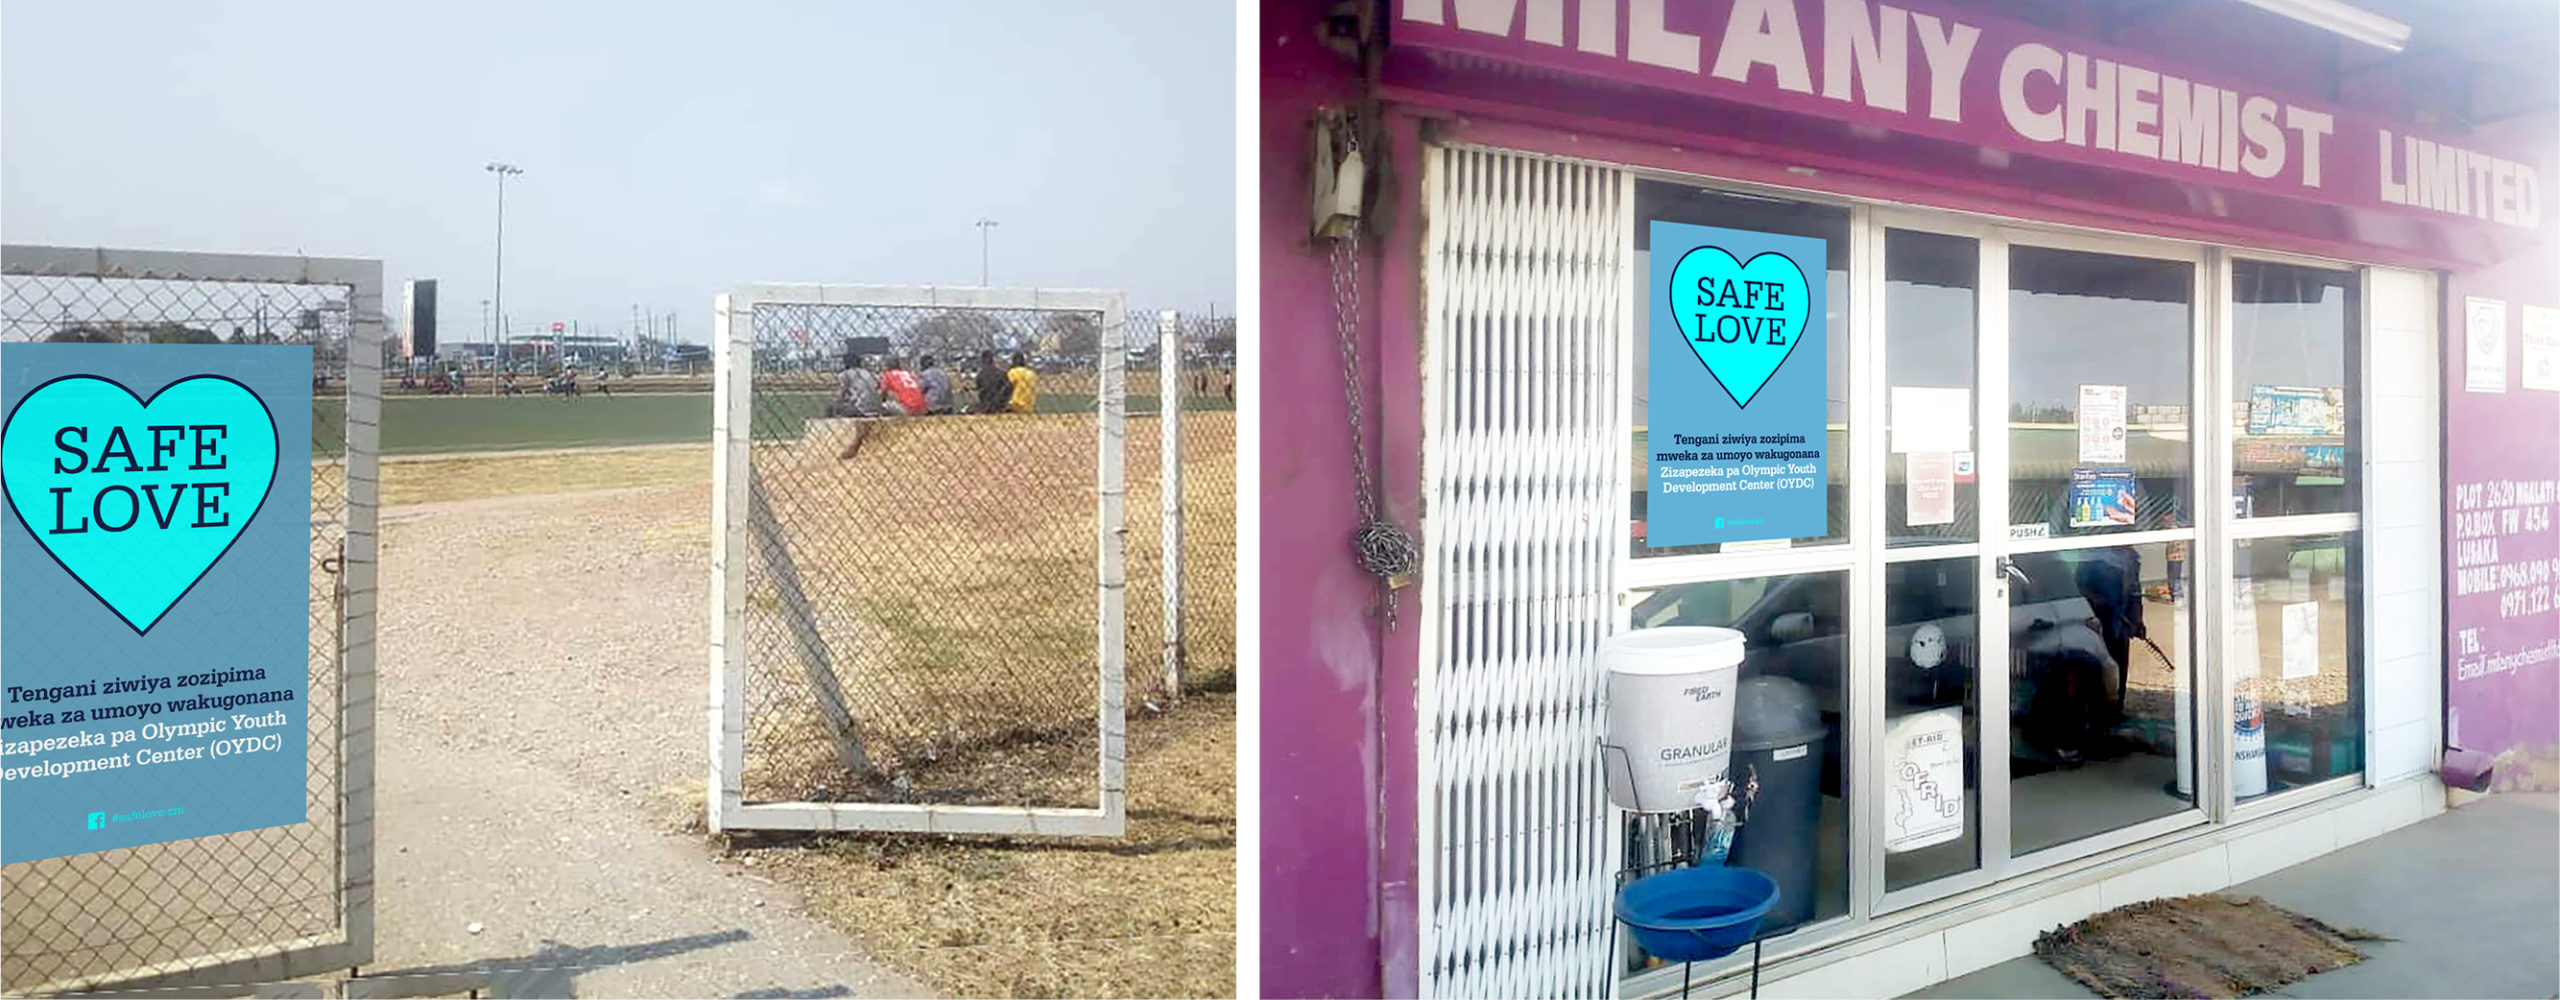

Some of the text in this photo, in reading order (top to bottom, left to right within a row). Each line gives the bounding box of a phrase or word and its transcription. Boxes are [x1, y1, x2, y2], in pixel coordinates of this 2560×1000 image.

[1999, 43, 2334, 189] CHEMIST
[2378, 129, 2542, 231] LIMITED
[1697, 275, 1785, 311] SAFE
[1694, 313, 1786, 346] LOVE
[54, 424, 228, 475] SAFE
[1656, 448, 1820, 463] mweka za umoyo wakugonana
[1673, 433, 1806, 447] Tengani ziwiya zozipima
[1660, 463, 1817, 479] Zizapezeka pa Olympic Youth
[1663, 477, 1815, 495] Development Center (OYDC)
[49, 482, 230, 535] LOVE
[2456, 483, 2483, 511] PLOT
[2010, 528, 2037, 538] PUSH
[2502, 508, 2520, 536] FW
[2525, 506, 2550, 532] 454
[2457, 537, 2498, 567] LUSAKA
[8, 666, 266, 704] Tengani ziwiya zozipima
[1696, 689, 1722, 702] EARTH
[61, 707, 85, 723] za
[91, 701, 162, 720] umoyo
[167, 689, 295, 711] wakugonana
[111, 729, 137, 746] pa
[142, 717, 227, 742] Olympic
[231, 710, 288, 730] Youth
[136, 742, 206, 766] Center
[210, 733, 283, 760] (OYDC)
